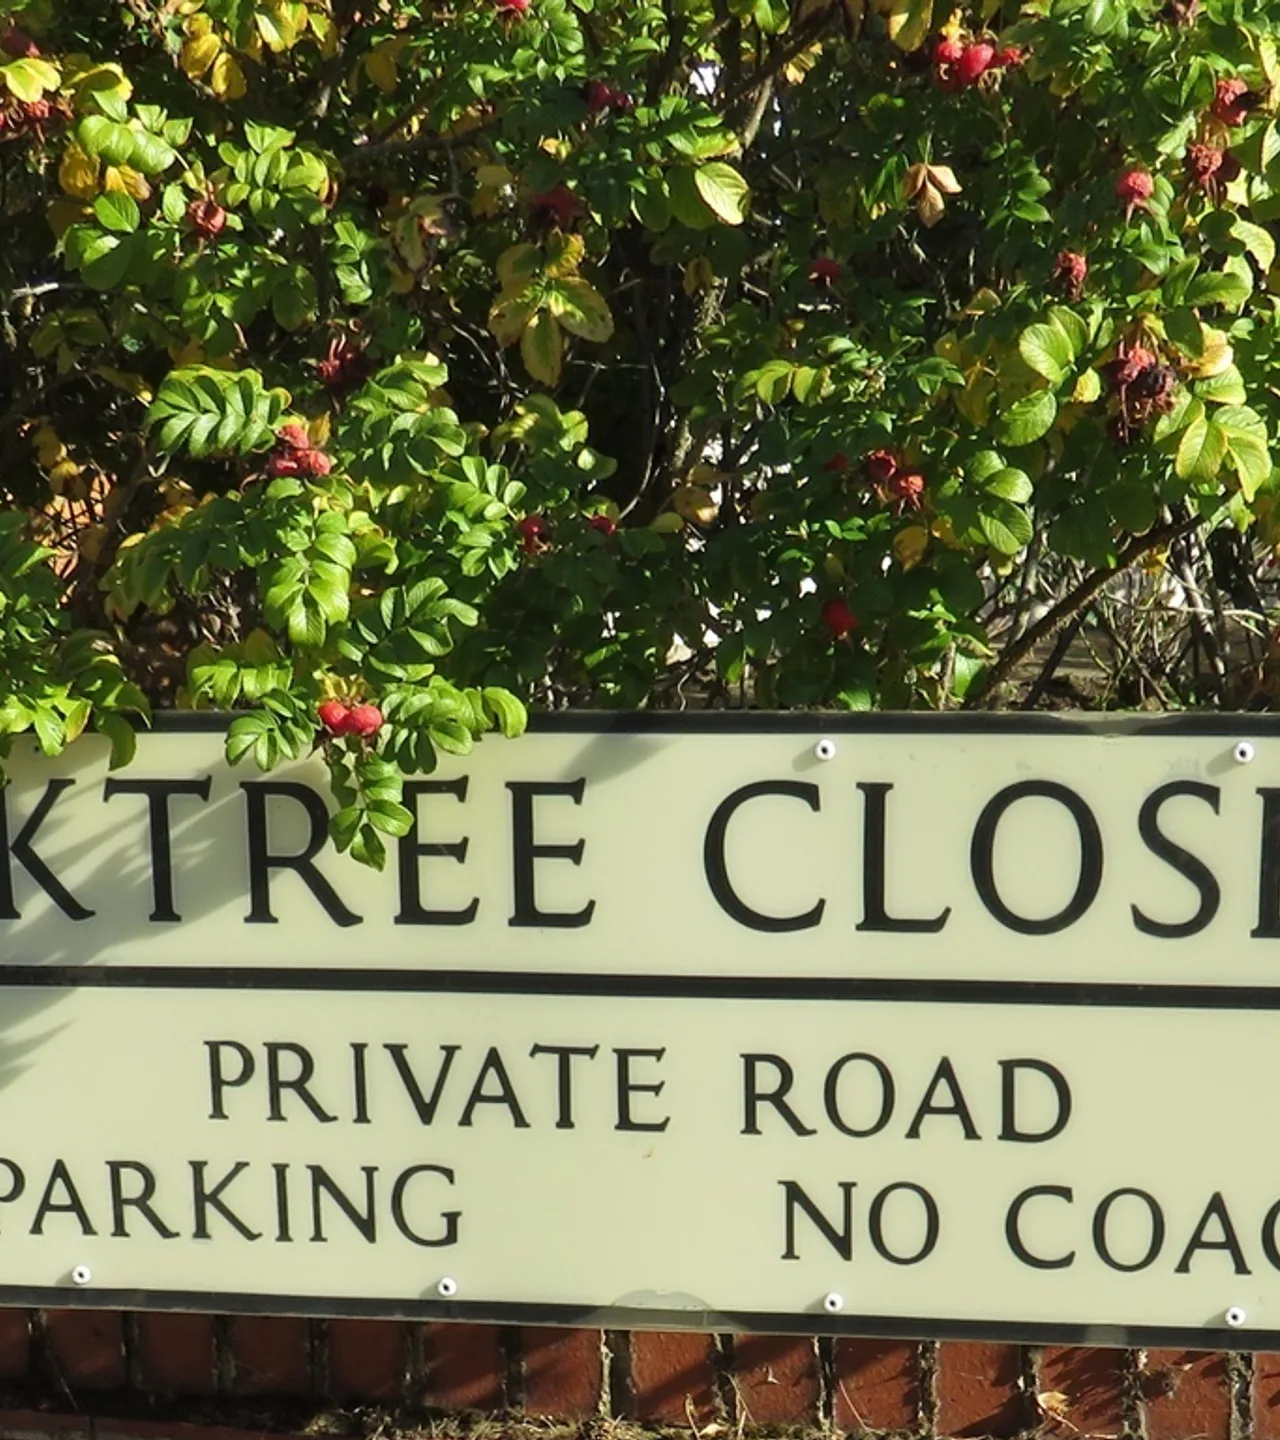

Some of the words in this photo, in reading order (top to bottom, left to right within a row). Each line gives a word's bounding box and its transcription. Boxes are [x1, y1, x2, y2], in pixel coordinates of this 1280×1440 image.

[203, 1040, 671, 1132] PRIVATE
[739, 1052, 1072, 1143] ROAD
[777, 1180, 940, 1265] NO
